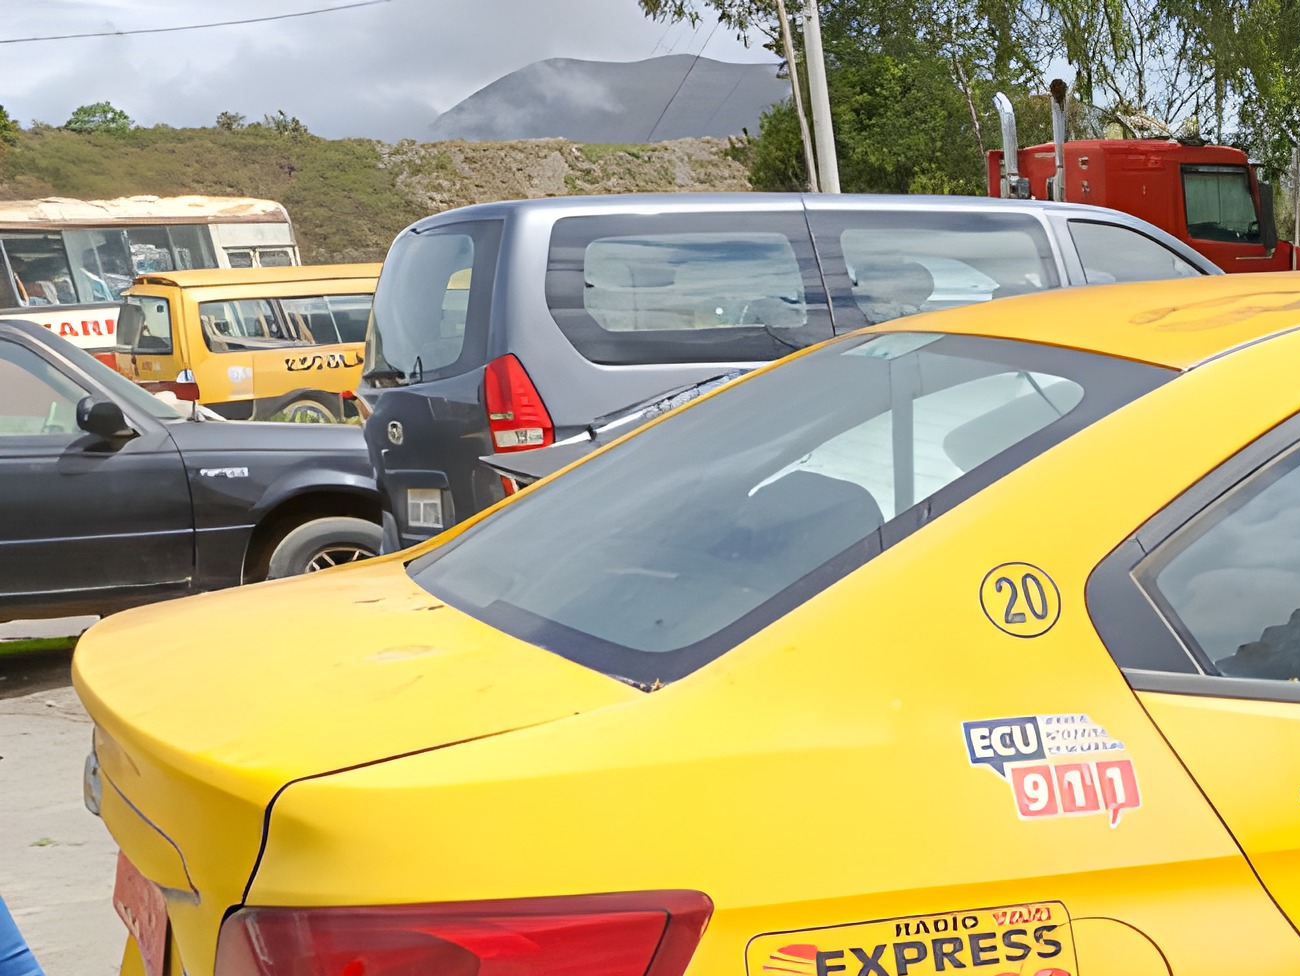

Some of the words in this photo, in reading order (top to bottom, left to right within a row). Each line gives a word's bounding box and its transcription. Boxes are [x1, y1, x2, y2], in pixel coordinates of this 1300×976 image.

[995, 573, 1048, 623] 20
[970, 723, 1039, 758] ECU
[1023, 767, 1126, 812] 911
